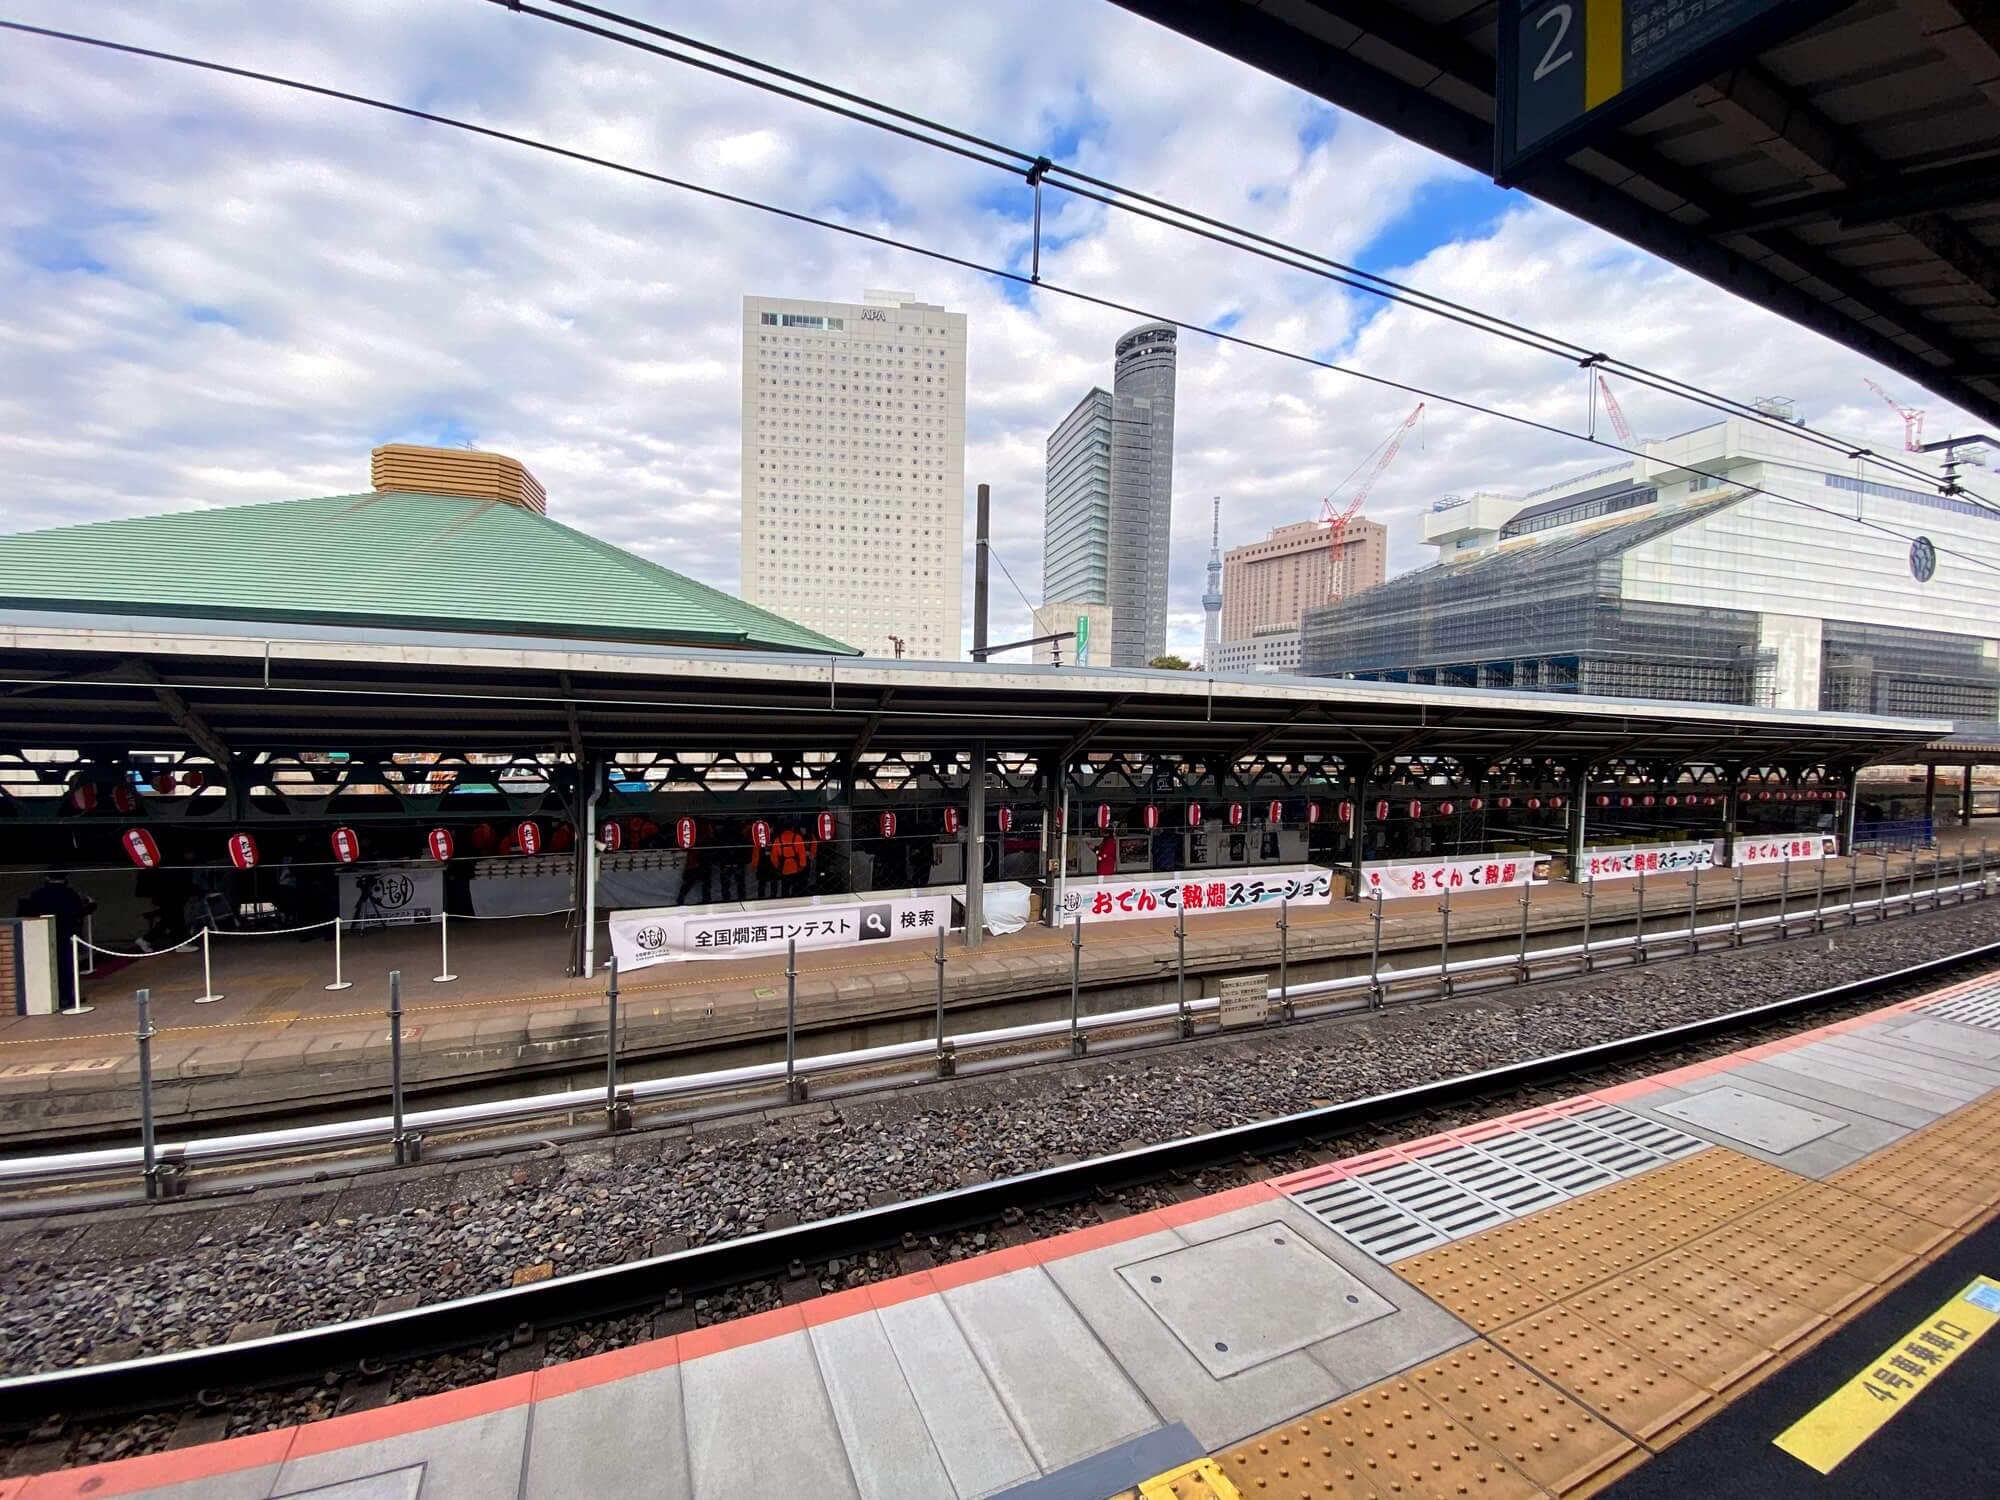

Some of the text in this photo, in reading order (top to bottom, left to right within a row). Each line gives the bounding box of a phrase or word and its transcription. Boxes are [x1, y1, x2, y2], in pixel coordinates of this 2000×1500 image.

[1533, 3, 1573, 82] 2
[900, 910, 935, 929] 検索
[1862, 1319, 1973, 1402] 4号車乗車口
